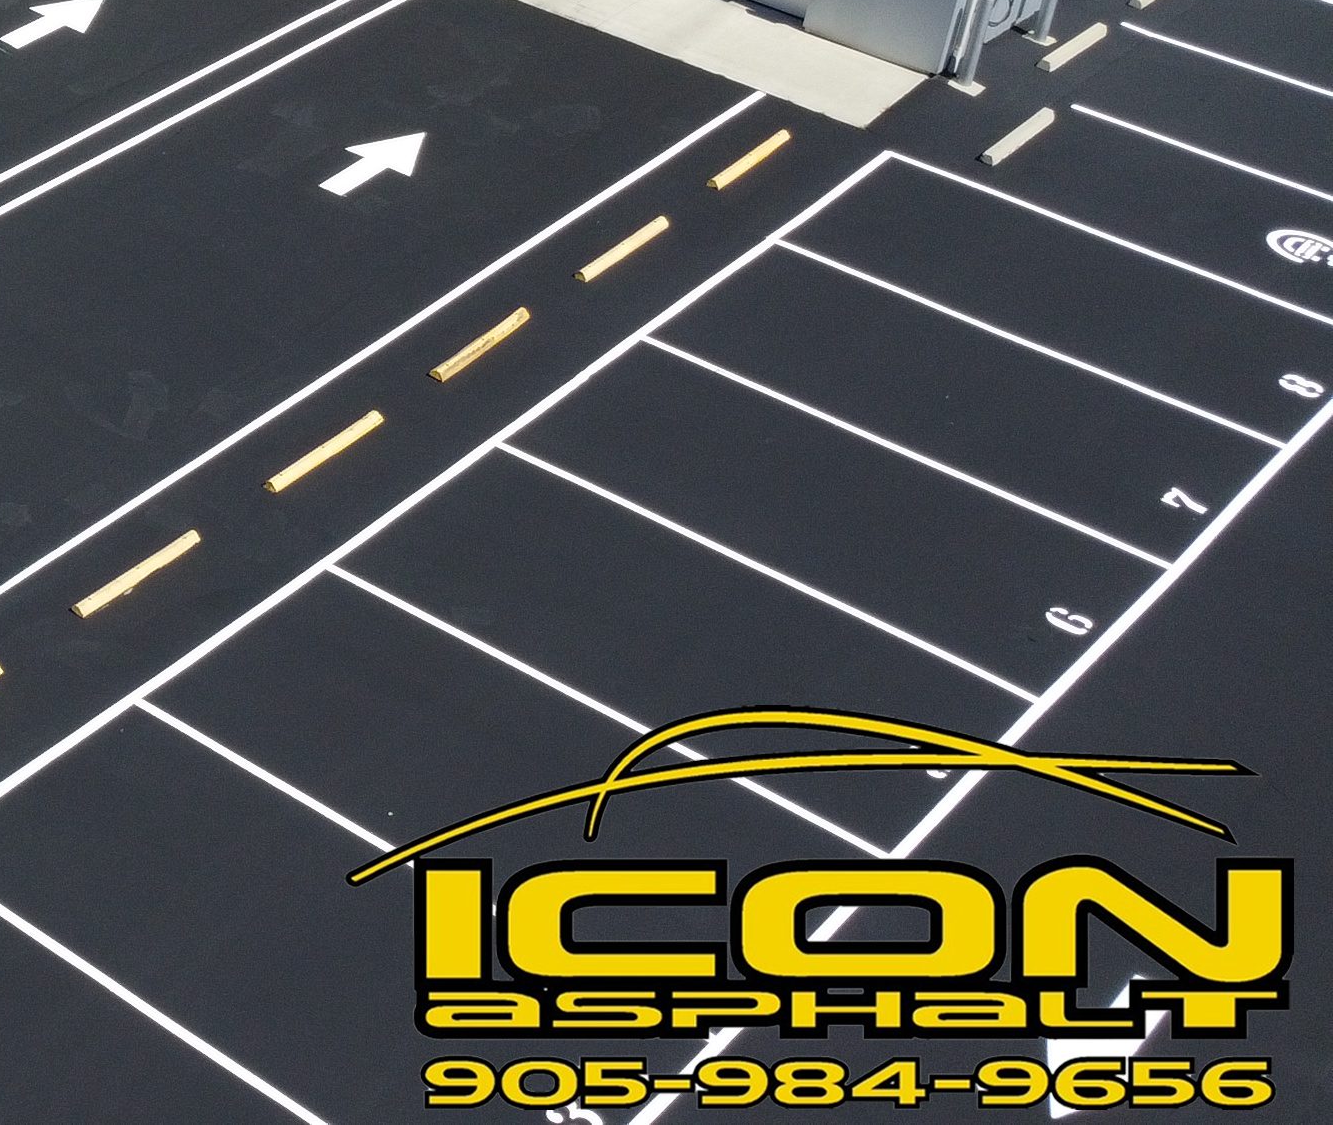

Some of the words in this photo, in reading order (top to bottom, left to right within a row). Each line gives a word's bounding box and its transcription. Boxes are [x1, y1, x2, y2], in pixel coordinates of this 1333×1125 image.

[1278, 374, 1325, 398] 8
[1160, 487, 1208, 514] 7
[1046, 607, 1093, 635] 6
